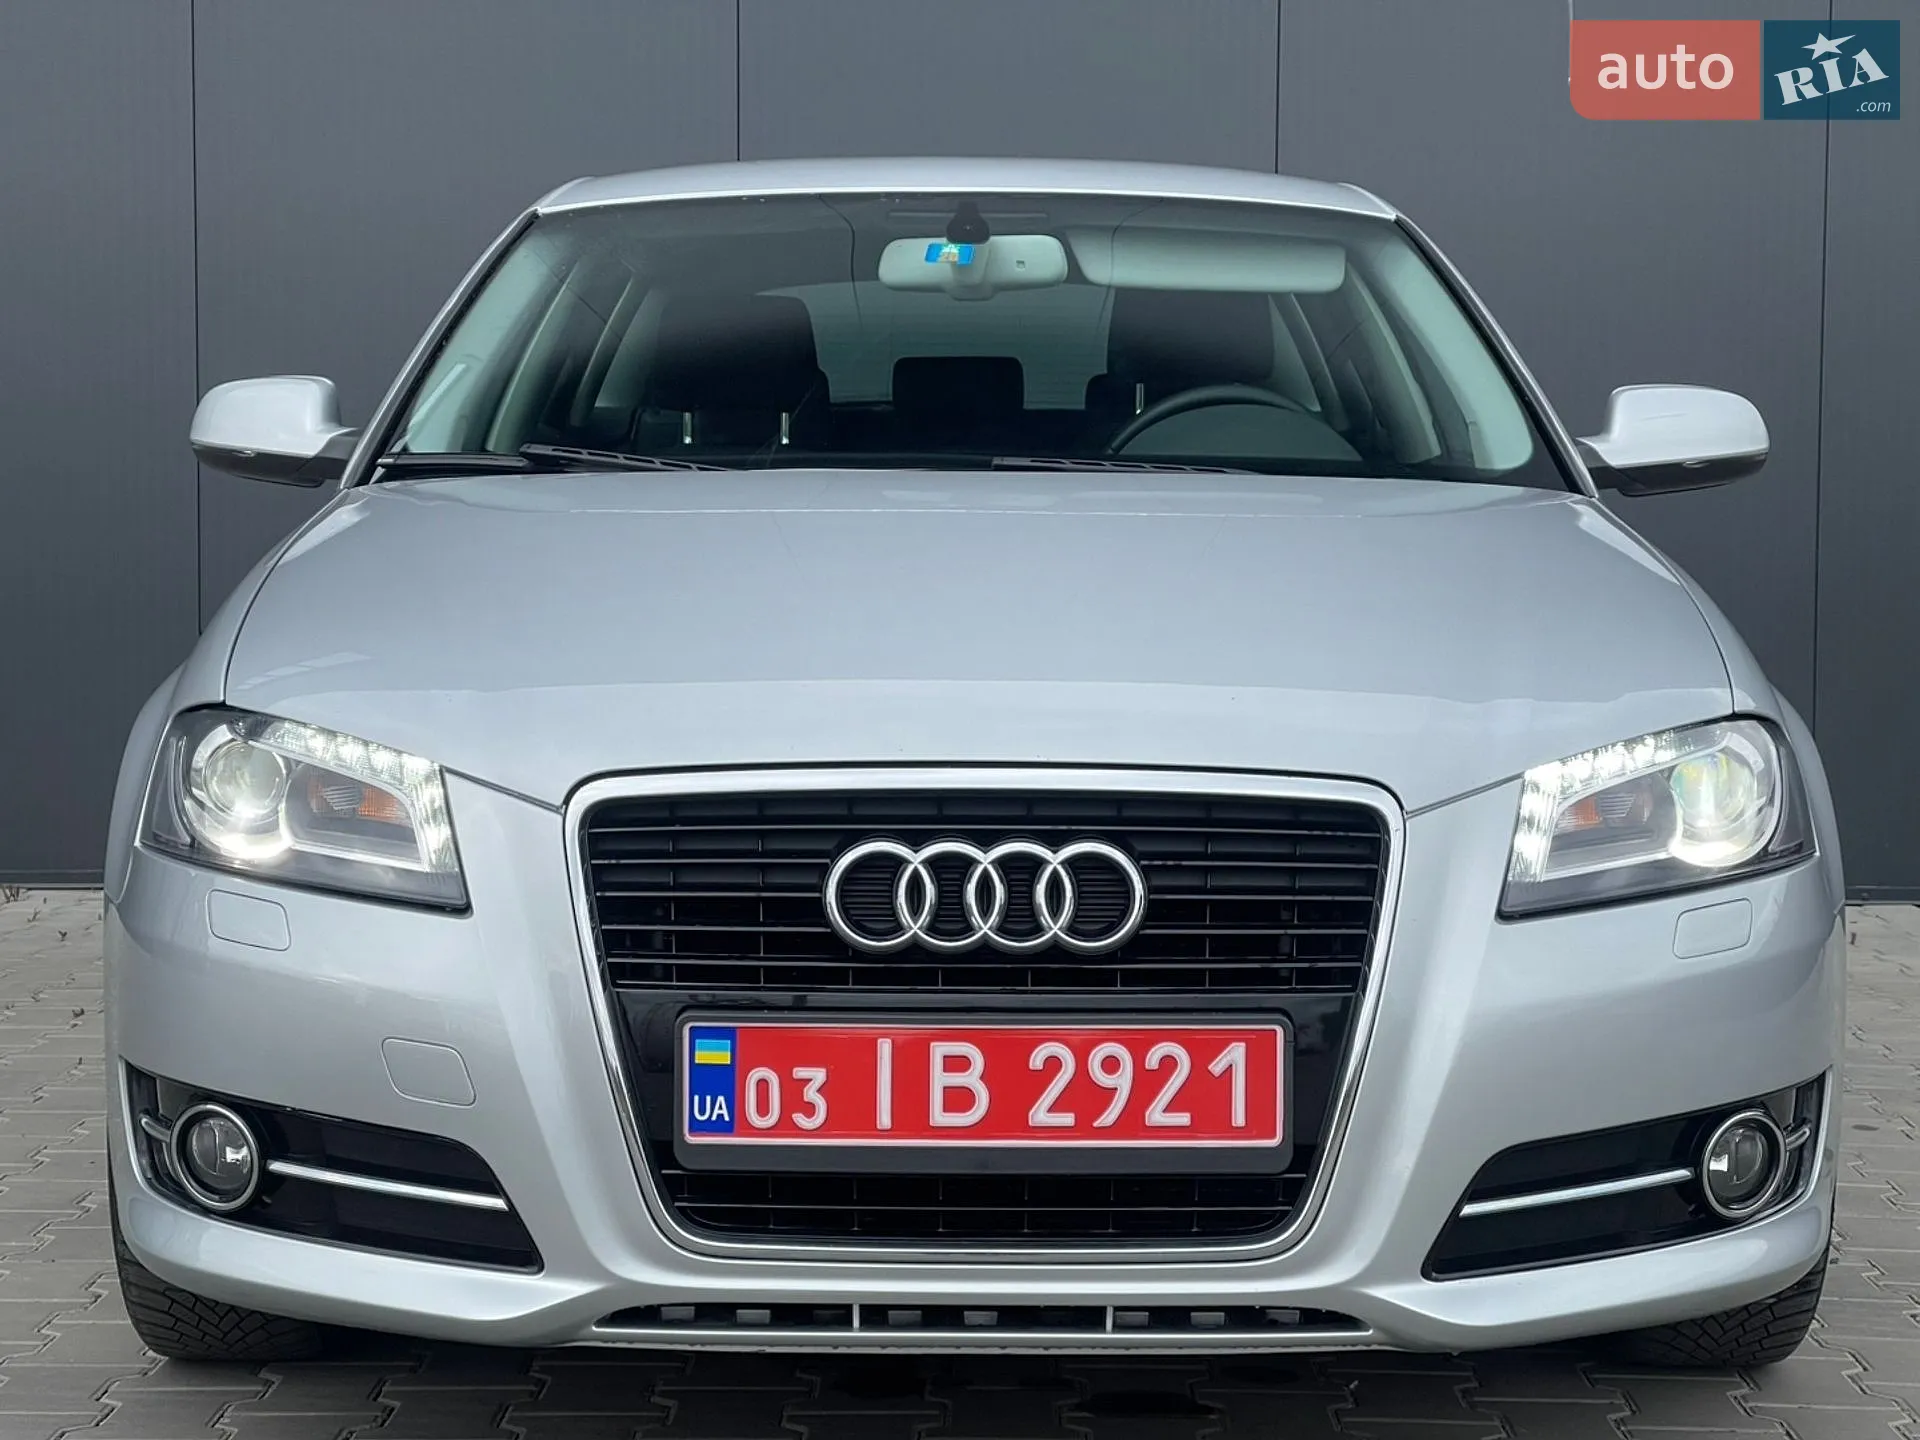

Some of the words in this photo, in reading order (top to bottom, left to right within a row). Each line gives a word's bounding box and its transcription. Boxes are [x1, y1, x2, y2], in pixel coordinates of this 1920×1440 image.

[692, 1095, 730, 1122] UA
[744, 1067, 828, 1130] 03
[1028, 1041, 1247, 1128] 2921
